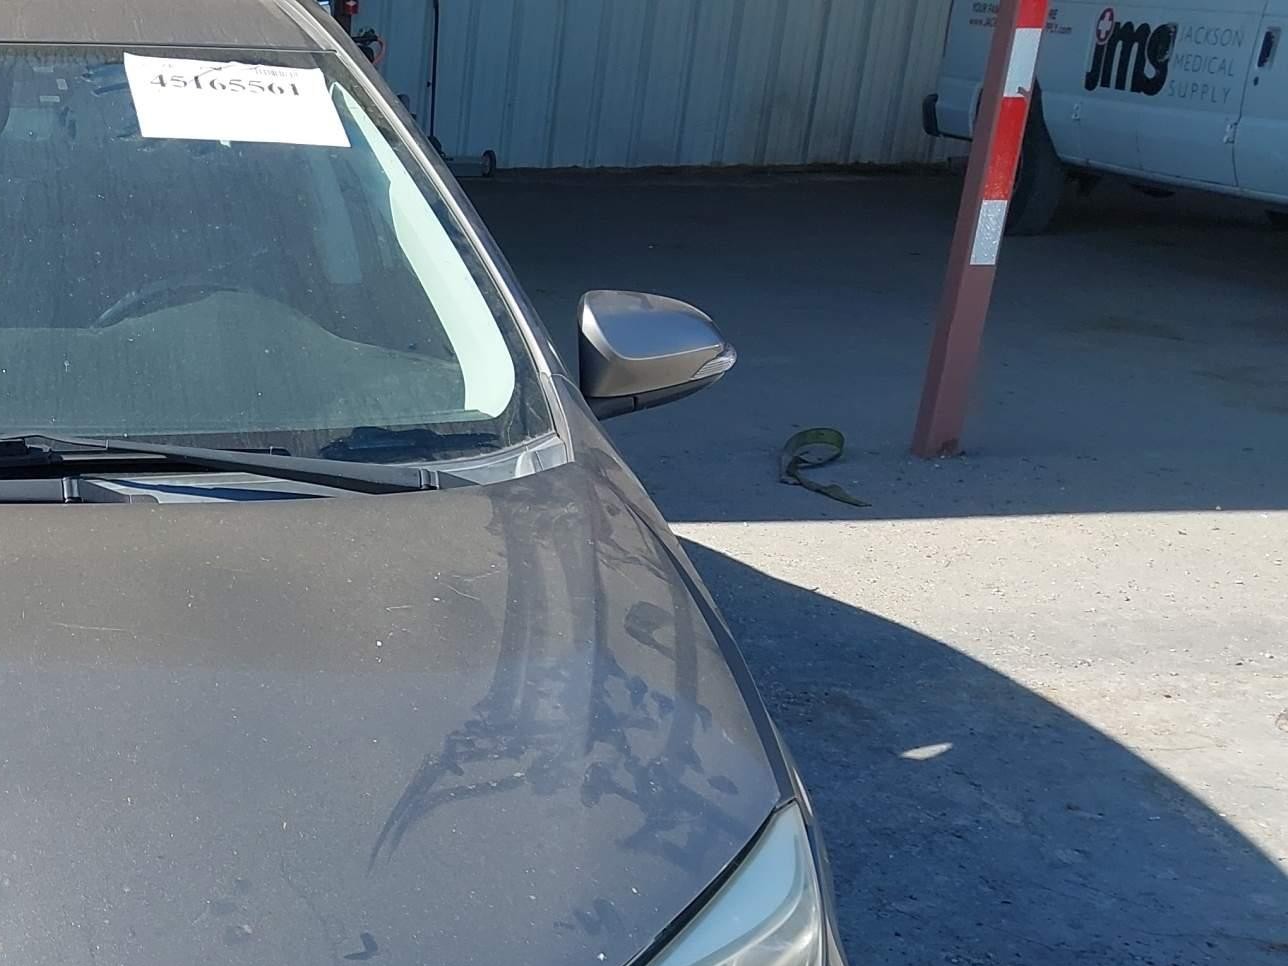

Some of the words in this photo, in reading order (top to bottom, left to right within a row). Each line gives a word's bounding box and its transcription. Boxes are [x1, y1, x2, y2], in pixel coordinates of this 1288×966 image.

[1177, 24, 1245, 48] JACKSON
[1172, 53, 1235, 77] MEDICAL
[1167, 79, 1231, 103] SUPPLY
